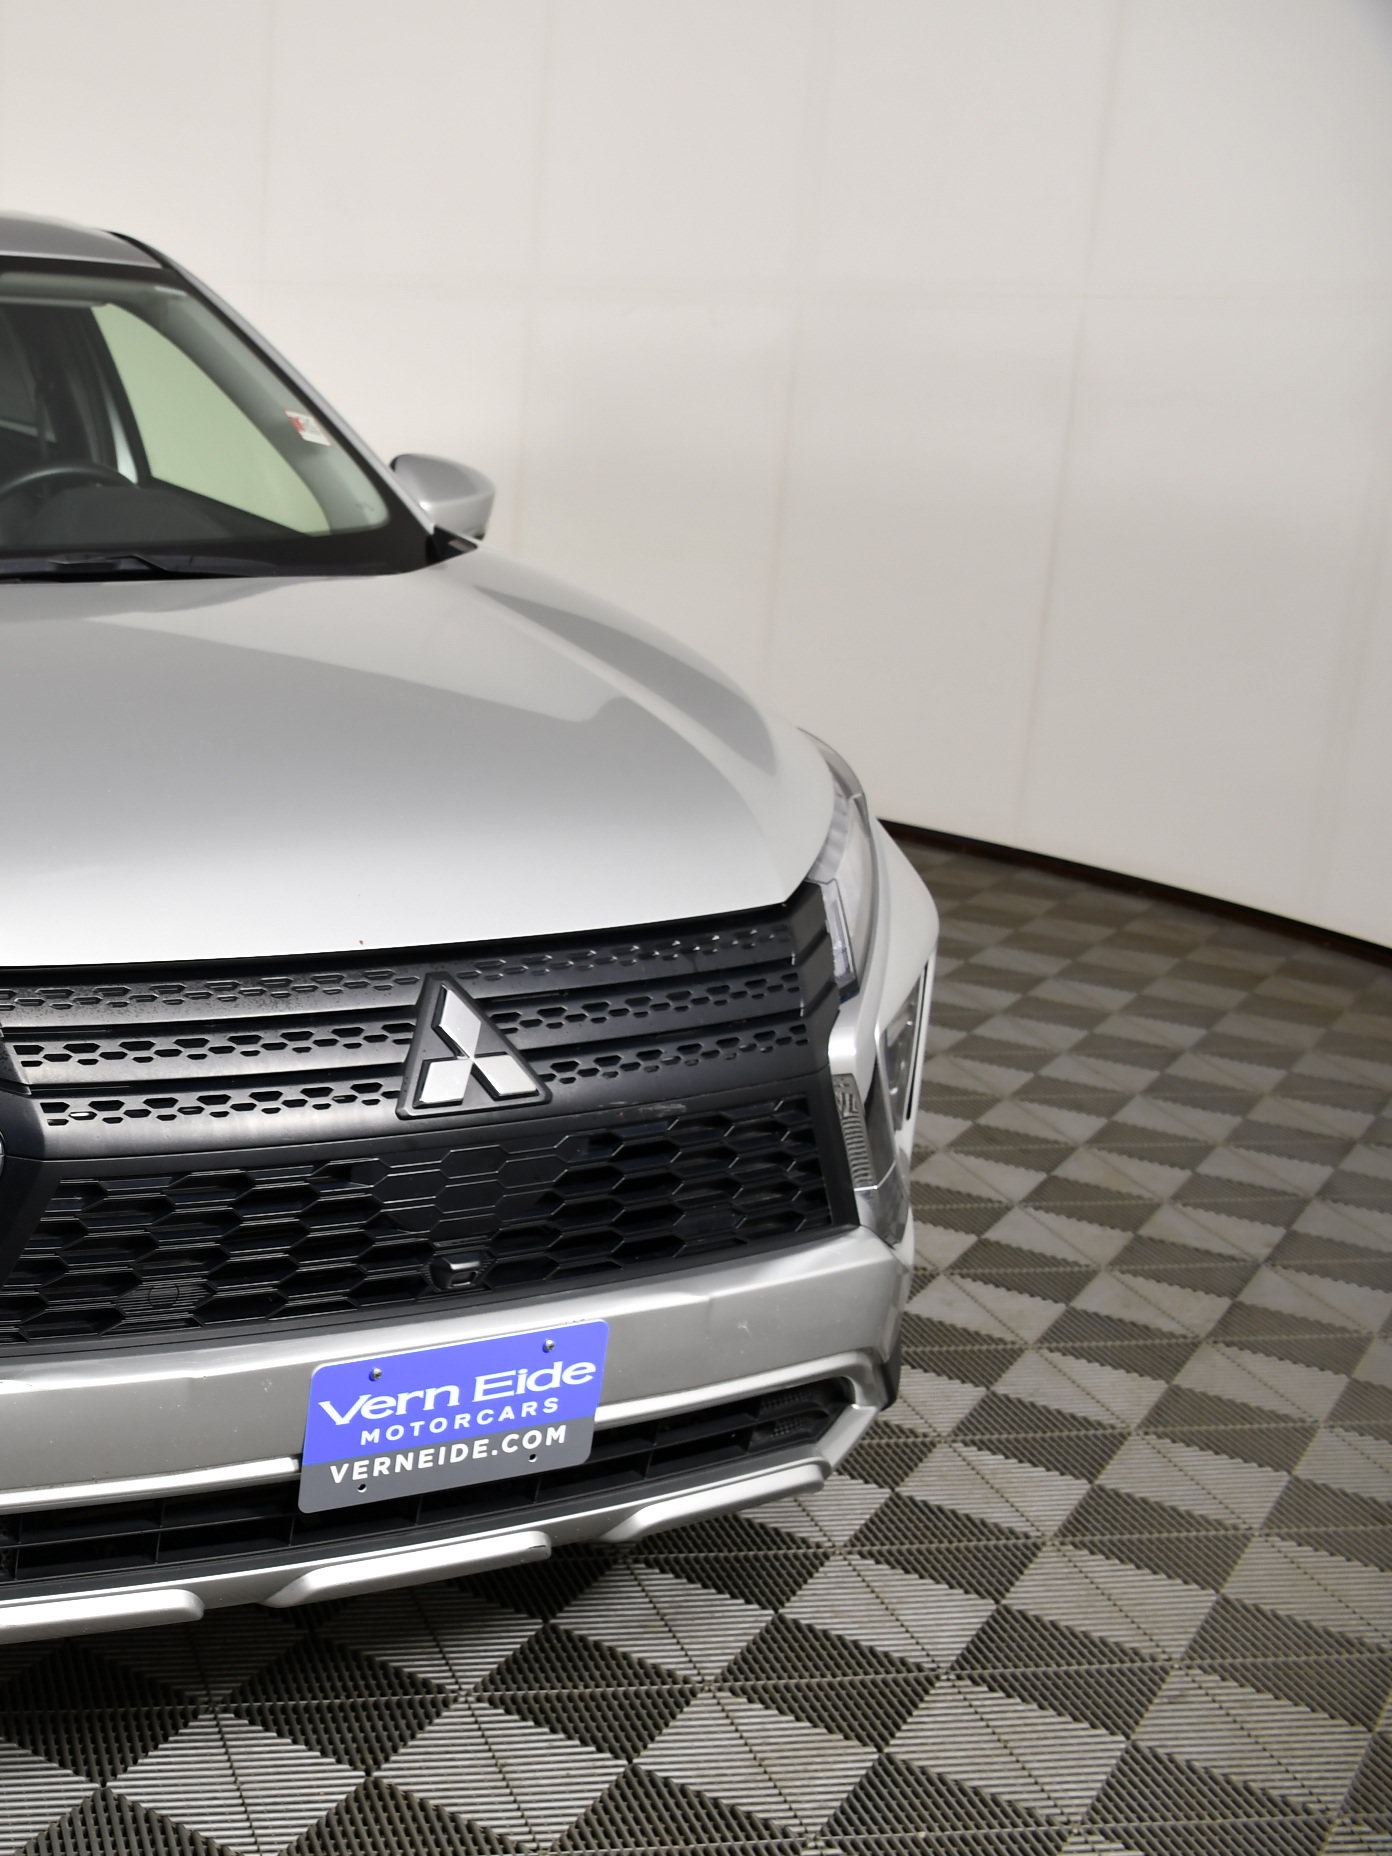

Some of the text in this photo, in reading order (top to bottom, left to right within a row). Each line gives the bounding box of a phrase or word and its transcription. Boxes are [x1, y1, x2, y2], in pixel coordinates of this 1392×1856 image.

[318, 1360, 596, 1426] Vern Eide
[360, 1397, 559, 1446] MOTORCARS
[329, 1424, 567, 1484] VERNEIDE.COM
